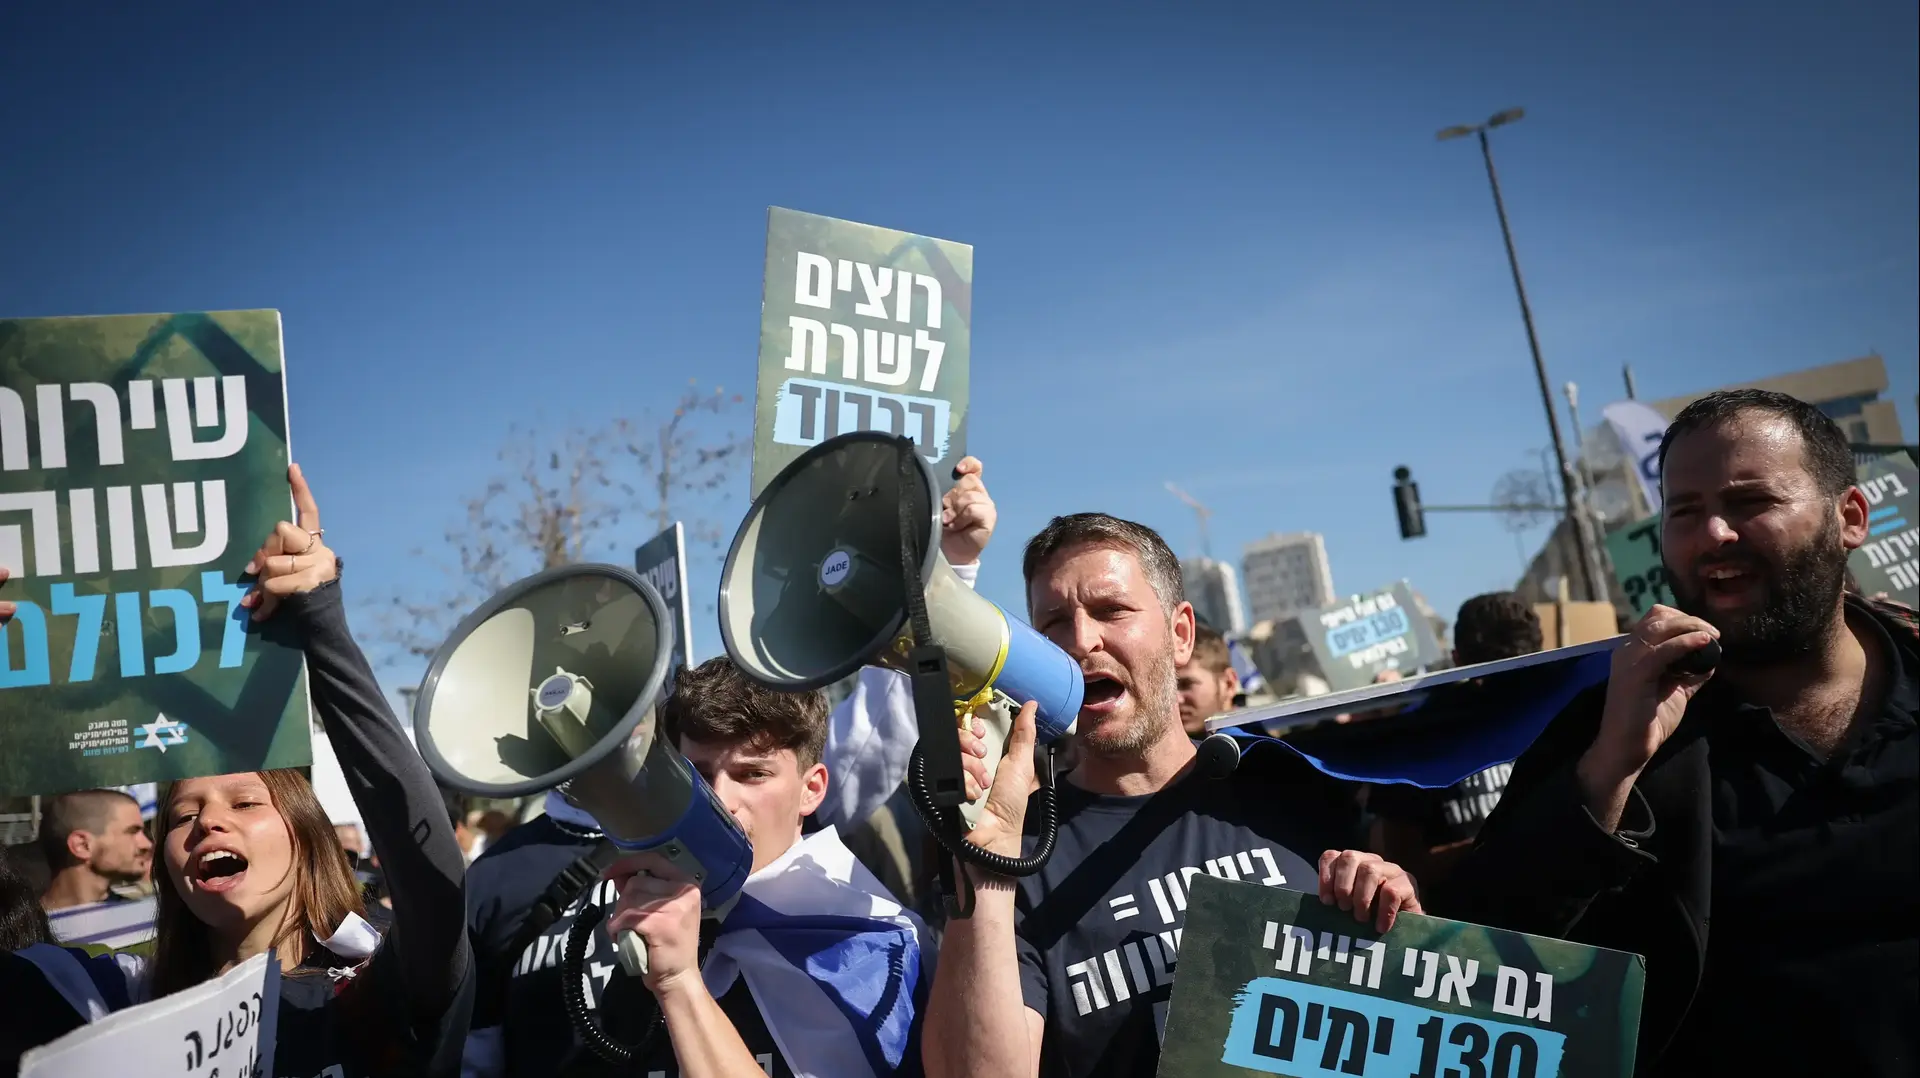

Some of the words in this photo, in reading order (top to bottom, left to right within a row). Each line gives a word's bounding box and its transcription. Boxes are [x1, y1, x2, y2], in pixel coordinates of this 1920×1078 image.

[795, 251, 942, 329] רוצים
[785, 316, 946, 392] לשרת
[0, 479, 228, 578] שווה
[825, 560, 847, 575] JADE
[0, 571, 254, 688] לכולם
[1262, 921, 1386, 990] הייתי
[1402, 947, 1479, 1009] אני
[1493, 965, 1553, 1023] גם
[184, 992, 262, 1071] הפגנה
[1253, 993, 1394, 1076] ימים
